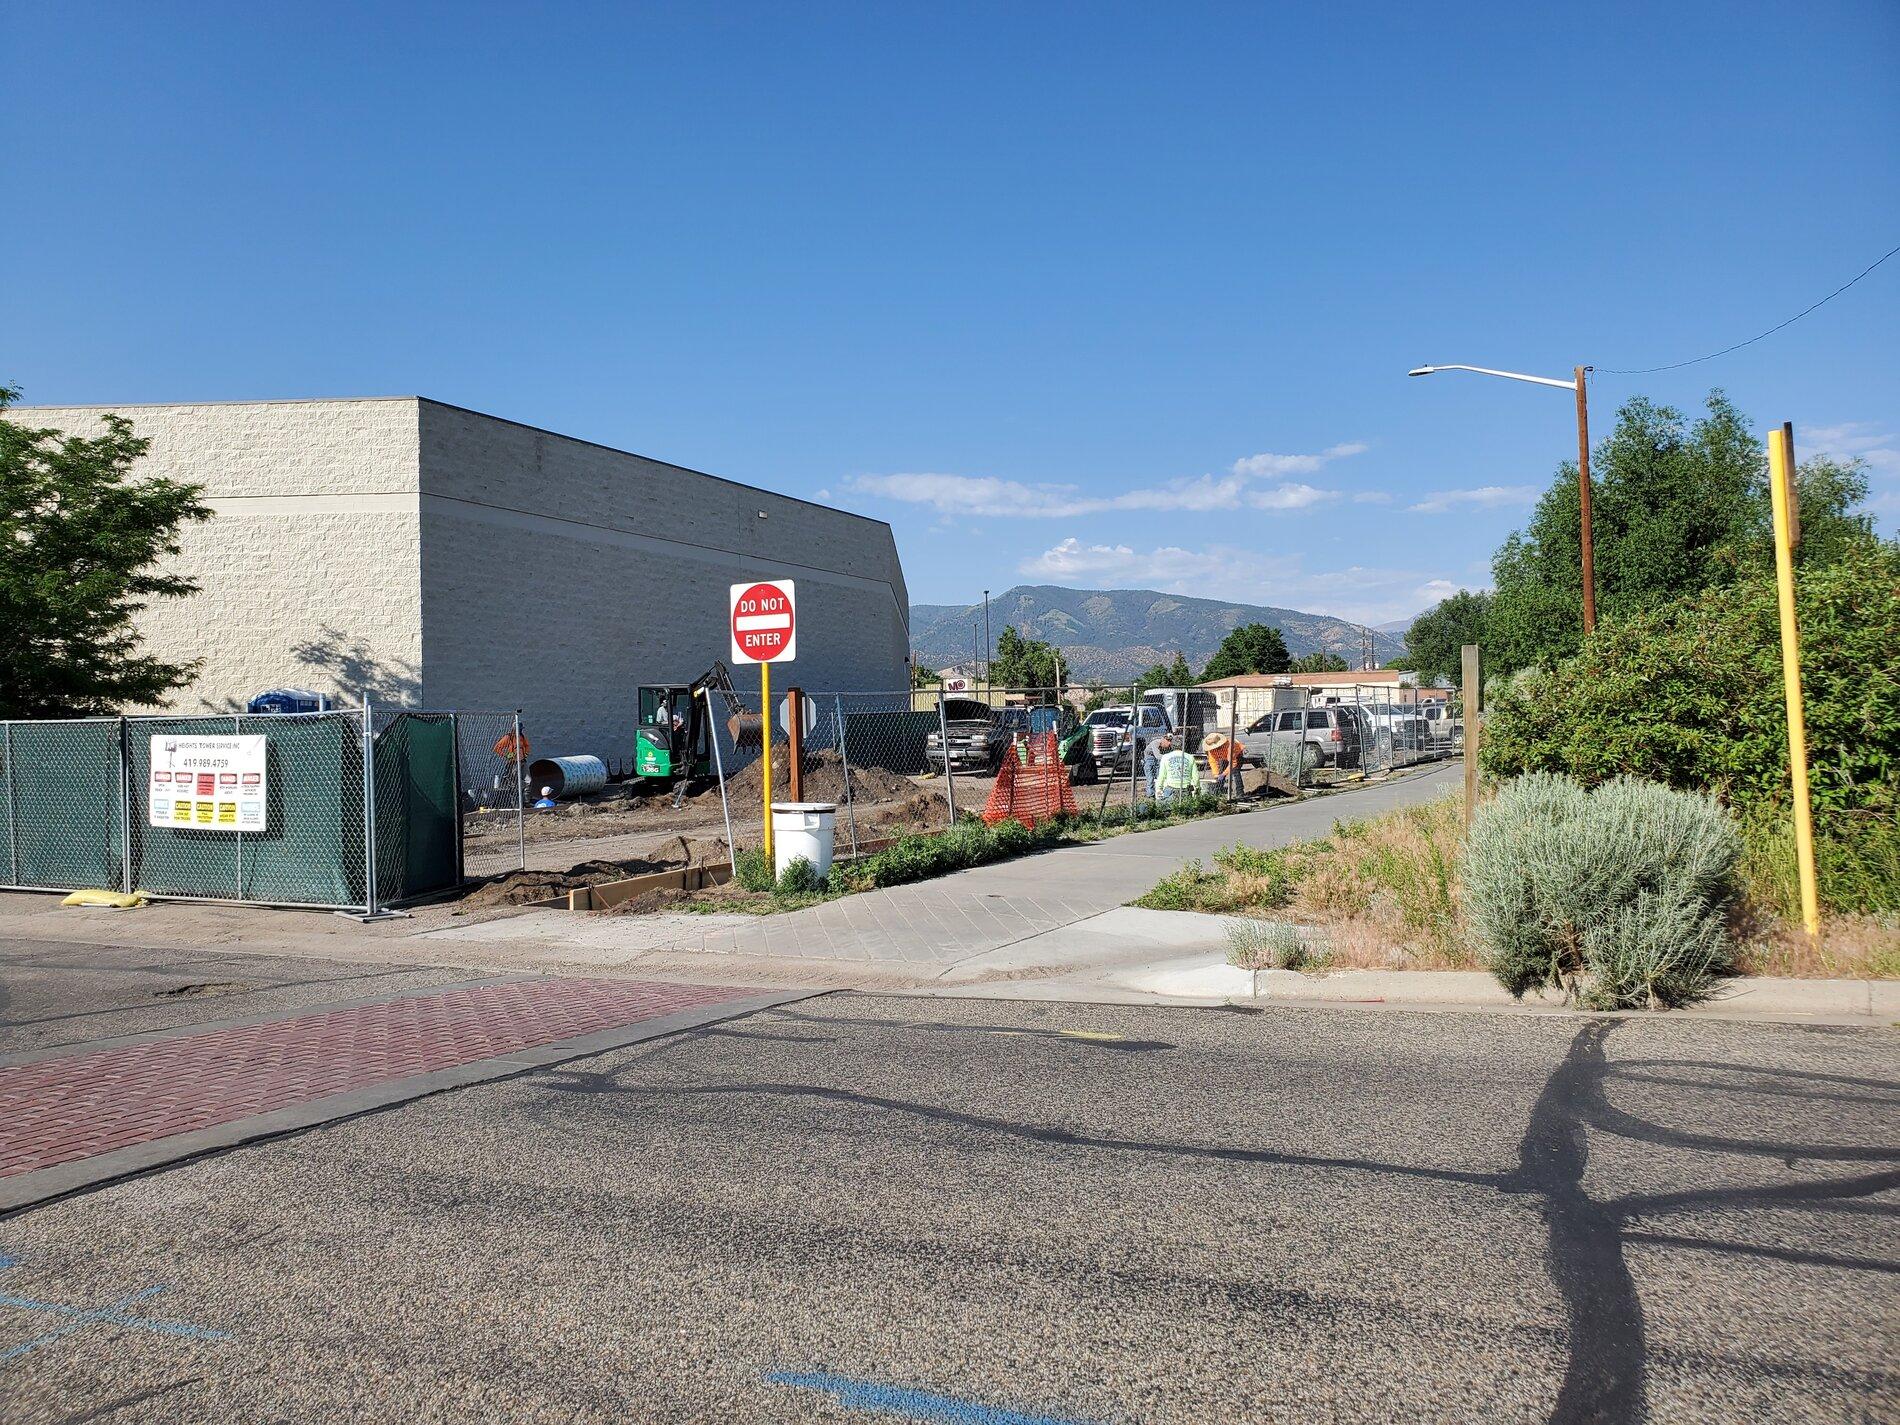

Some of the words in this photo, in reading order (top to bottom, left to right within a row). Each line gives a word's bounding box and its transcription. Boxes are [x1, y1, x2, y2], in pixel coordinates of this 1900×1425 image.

[741, 600, 756, 612] DO
[761, 597, 784, 611] NOT
[745, 633, 781, 647] ENTER
[183, 759, 229, 768] 419.989.4759
